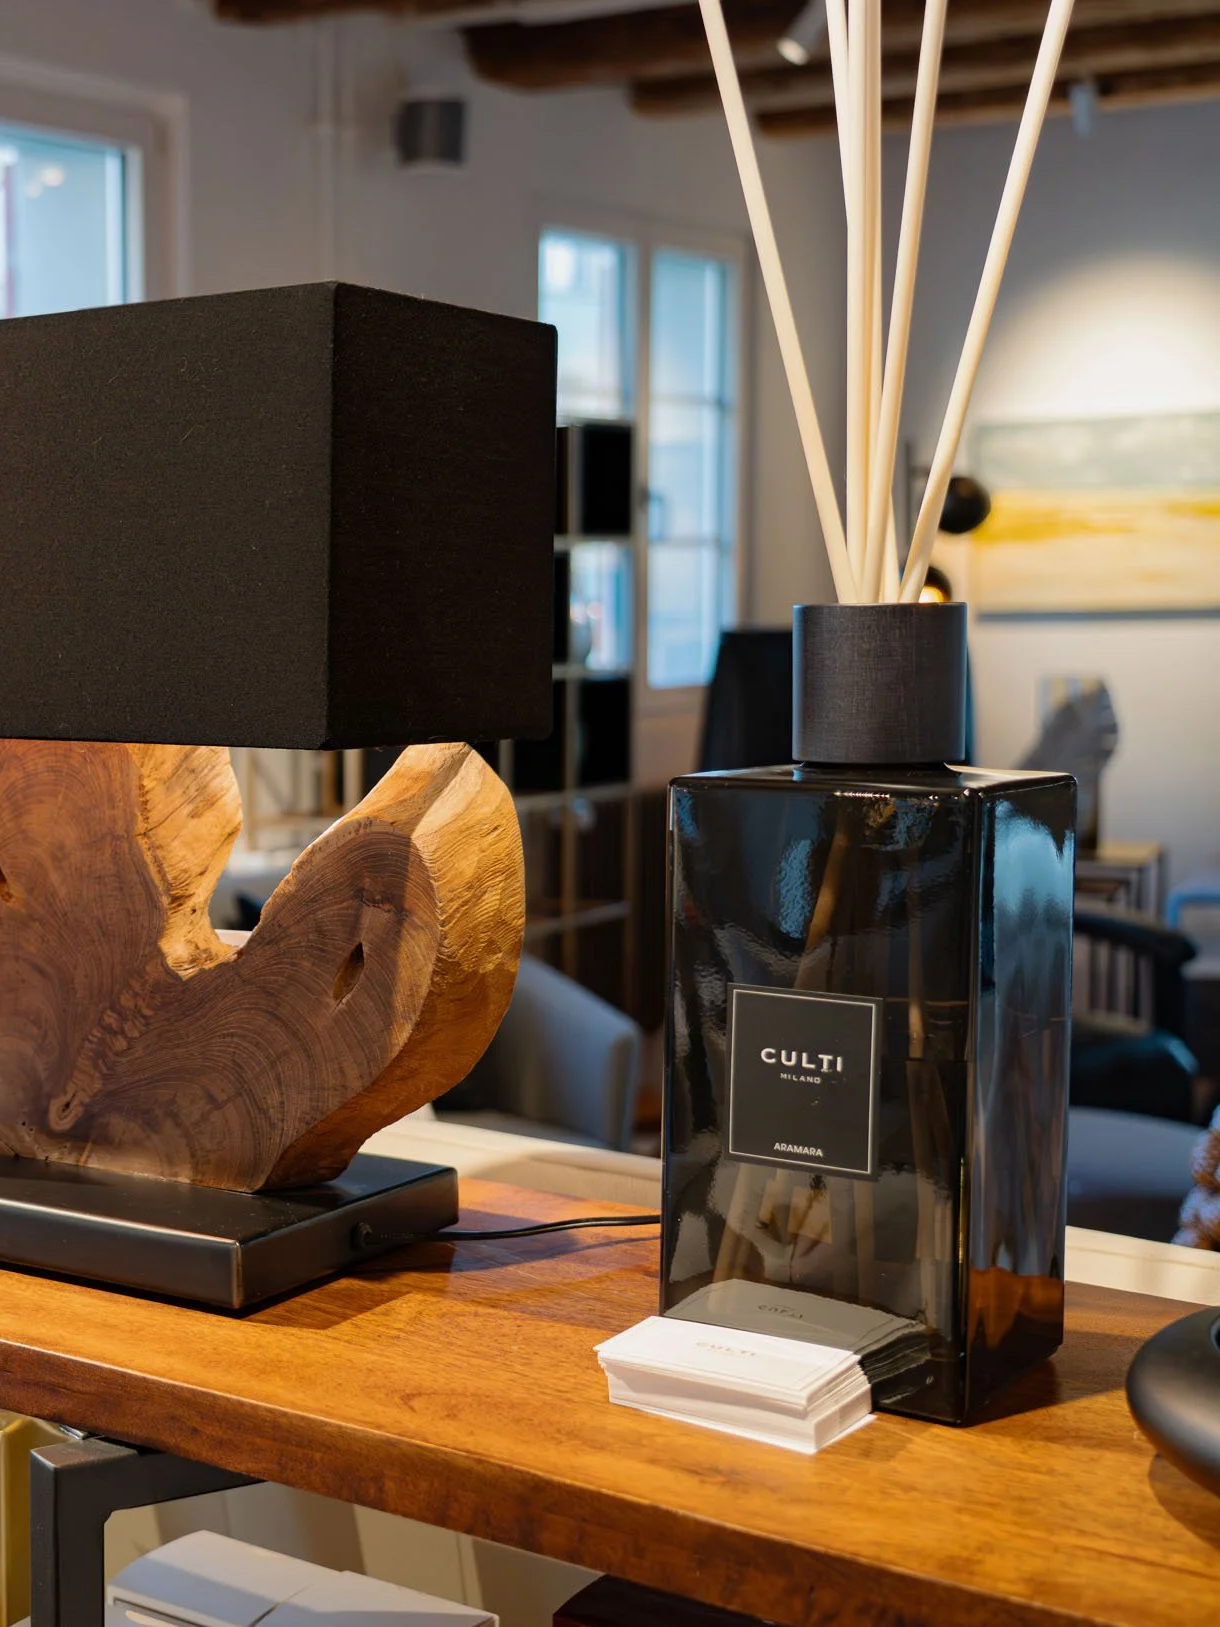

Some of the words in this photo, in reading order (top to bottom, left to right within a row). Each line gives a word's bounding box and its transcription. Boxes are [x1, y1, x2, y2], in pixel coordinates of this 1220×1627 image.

[760, 1047, 844, 1073] CULTI
[780, 1072, 822, 1085] MILANO
[773, 1142, 824, 1158] ARAMARA
